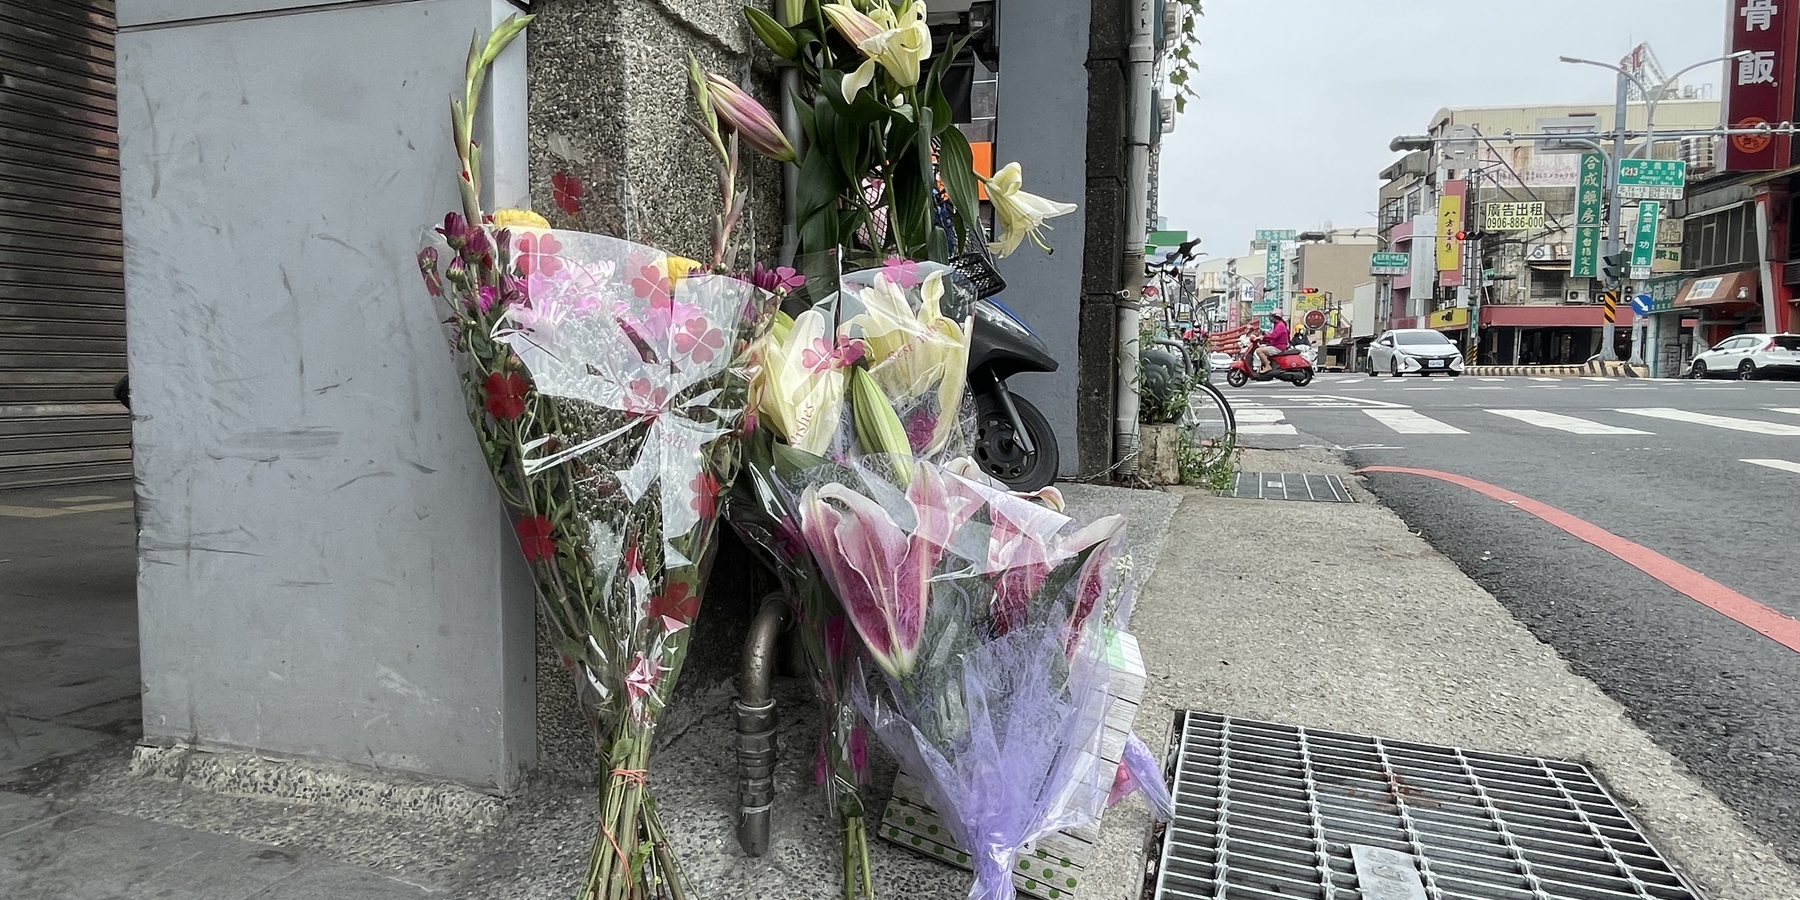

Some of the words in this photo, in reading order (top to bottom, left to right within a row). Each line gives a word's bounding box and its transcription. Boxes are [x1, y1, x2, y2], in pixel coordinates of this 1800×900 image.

[1738, 0, 1778, 87] 骨飯
[1625, 167, 1639, 176] 213
[1581, 156, 1600, 223] 合成藥房
[1487, 217, 1544, 228] 0906-886-000
[1488, 203, 1543, 217] 廣告出租
[1579, 227, 1594, 275] 電台指定店
